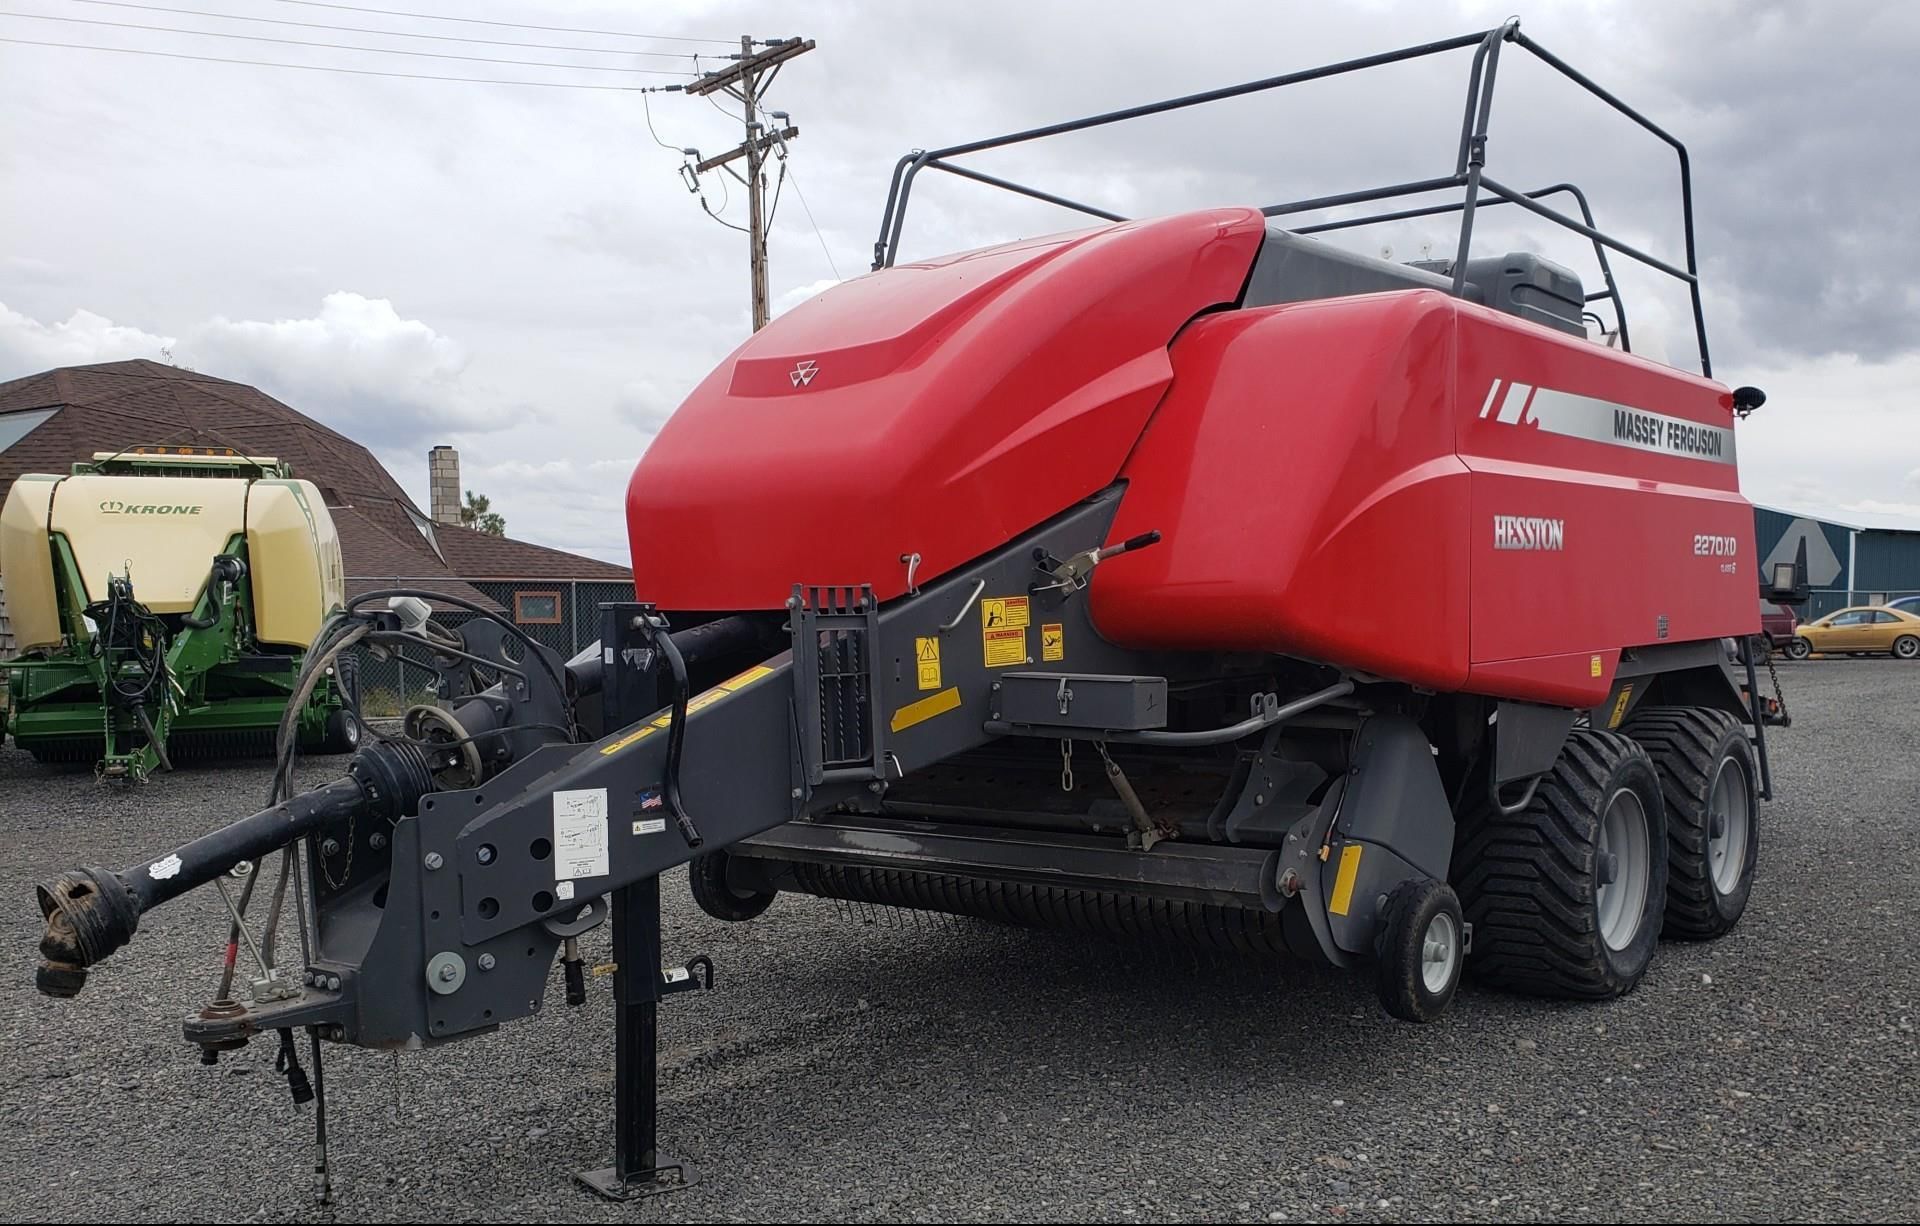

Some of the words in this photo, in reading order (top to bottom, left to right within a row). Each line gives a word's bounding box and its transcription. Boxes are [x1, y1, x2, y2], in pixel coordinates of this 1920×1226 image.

[1614, 409, 1664, 447] MASSEY
[1667, 422, 1721, 456] FERGUSON
[124, 505, 203, 515] KRONE
[1494, 515, 1564, 551] HESSTON
[1694, 534, 1737, 556] 2270XD
